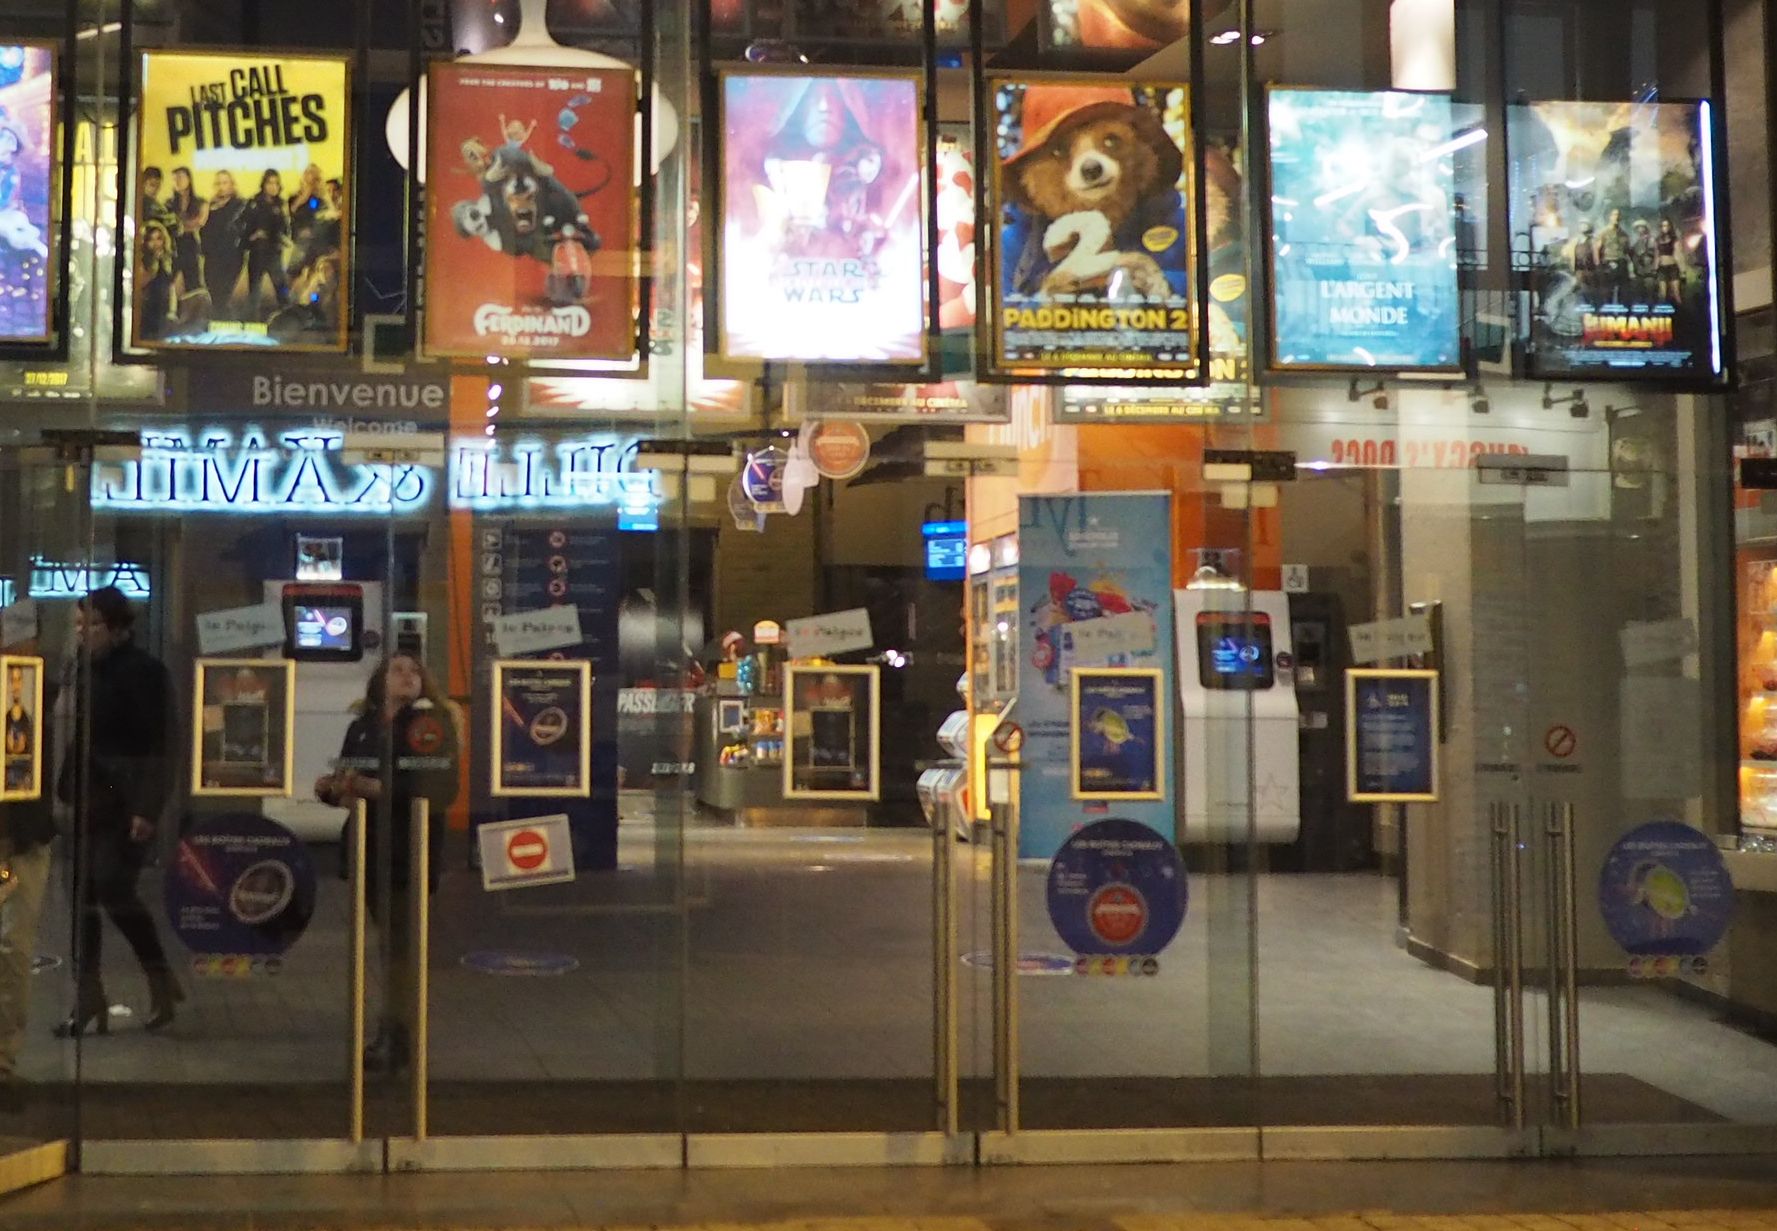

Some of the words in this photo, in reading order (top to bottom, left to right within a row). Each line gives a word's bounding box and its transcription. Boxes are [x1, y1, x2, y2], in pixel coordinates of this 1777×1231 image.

[190, 82, 228, 109] LAST
[230, 65, 288, 101] CALL
[166, 94, 328, 155] PITCHES
[785, 261, 865, 278] STAR
[784, 287, 864, 304] WARS
[1320, 279, 1414, 299] L'ARGENT
[474, 303, 591, 337] FERDINAND
[1003, 307, 1167, 330] PADDINGTON
[1170, 309, 1189, 329] 2
[1330, 306, 1408, 325] MONDE
[254, 375, 444, 408] Bienvenue
[312, 416, 418, 434] Welcome
